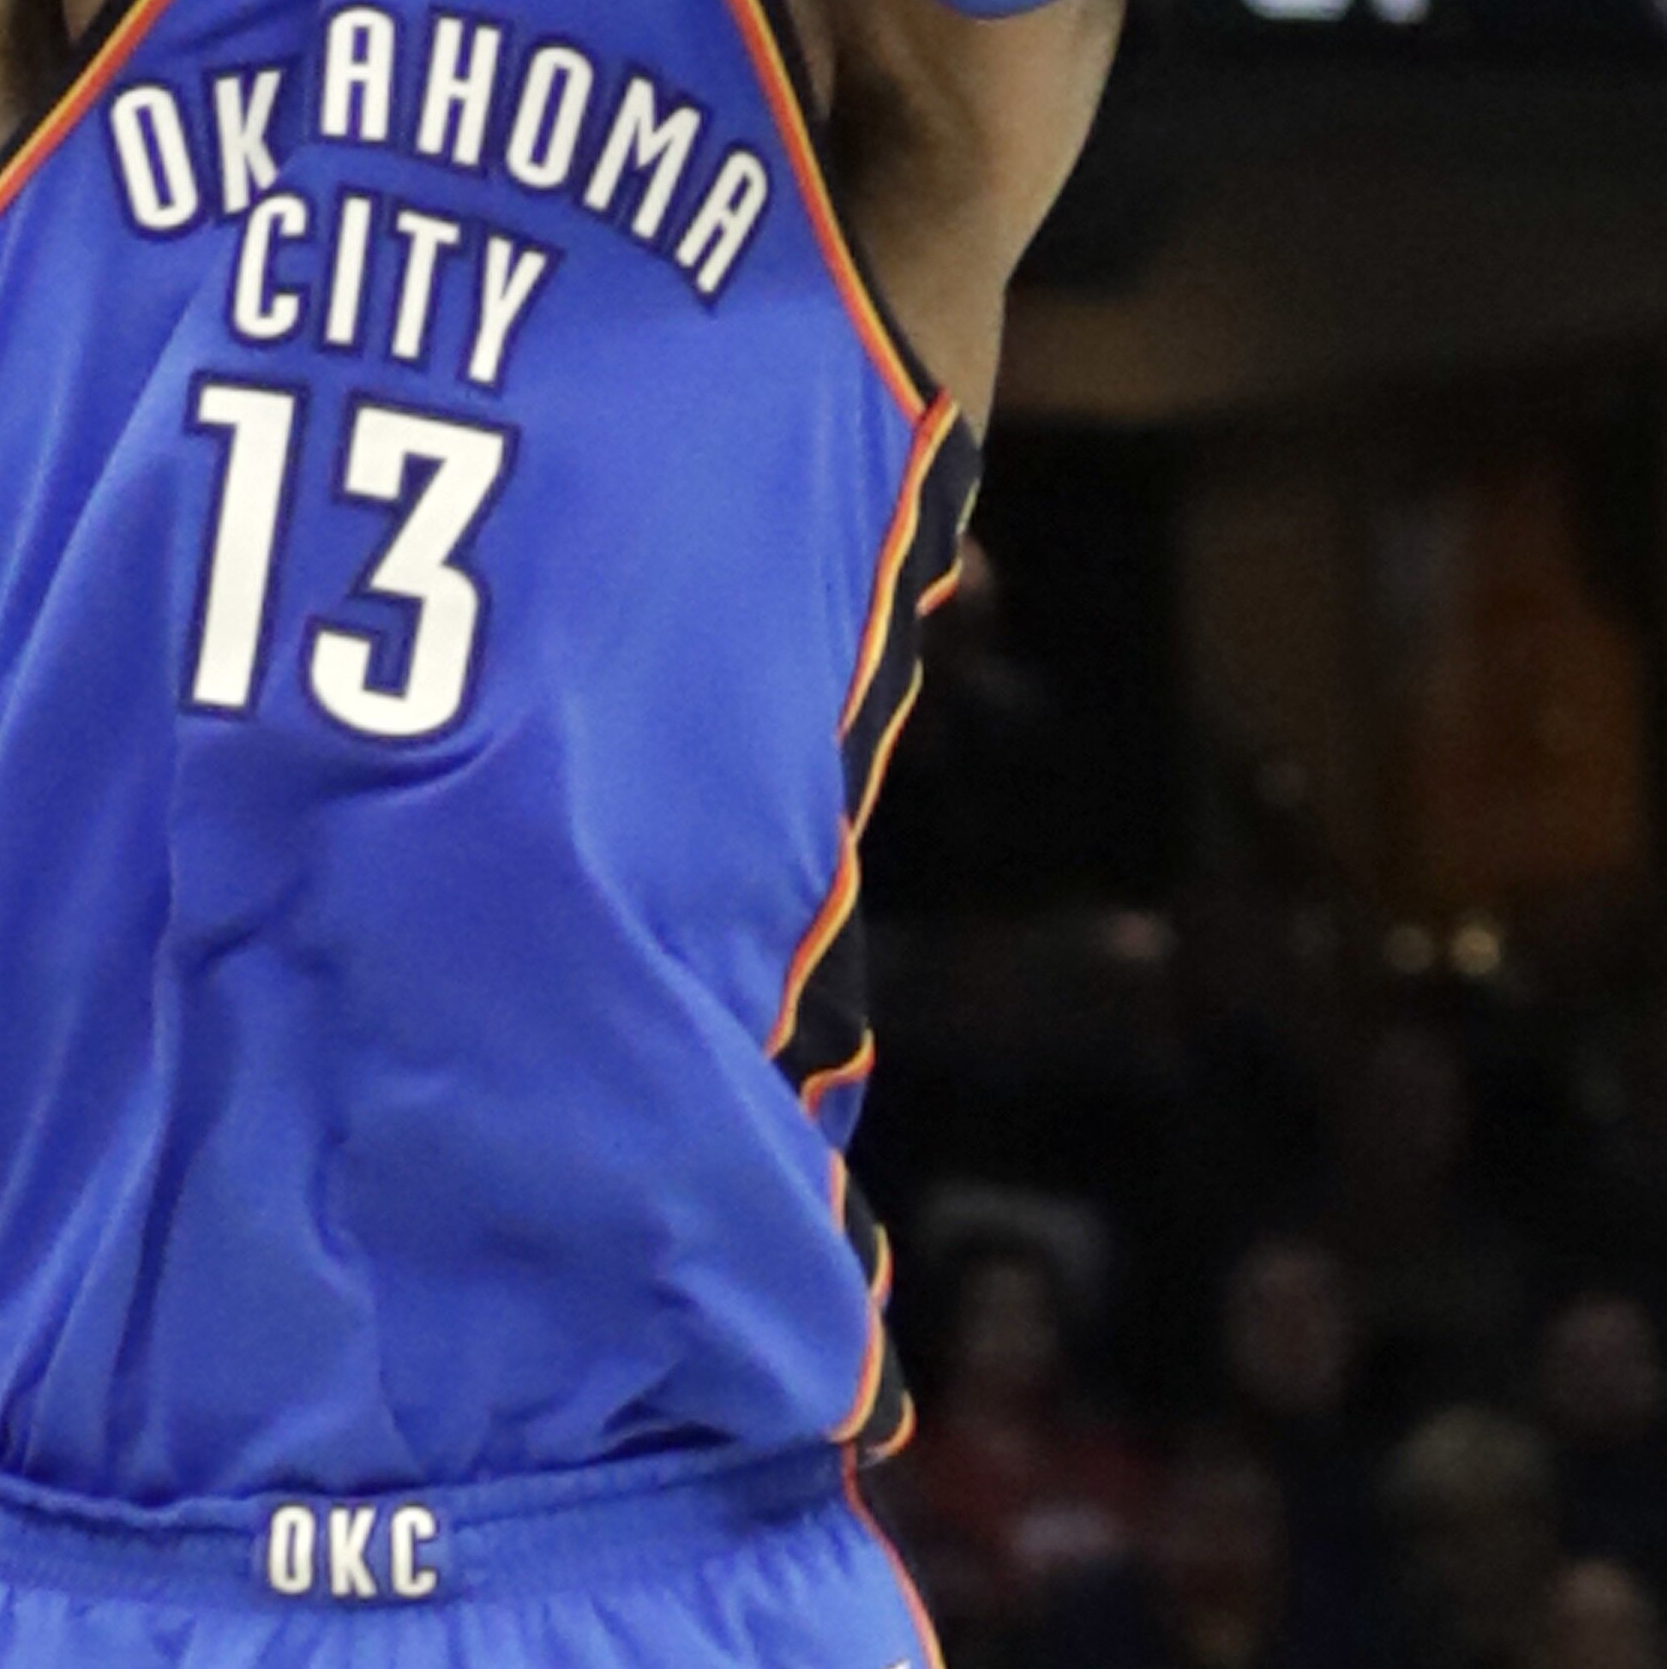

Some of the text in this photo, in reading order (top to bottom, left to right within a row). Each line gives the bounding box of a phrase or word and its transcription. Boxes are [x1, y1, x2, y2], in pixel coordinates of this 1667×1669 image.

[230, 193, 549, 387] CITY
[188, 381, 512, 739] 13
[268, 1503, 438, 1598] OKC
